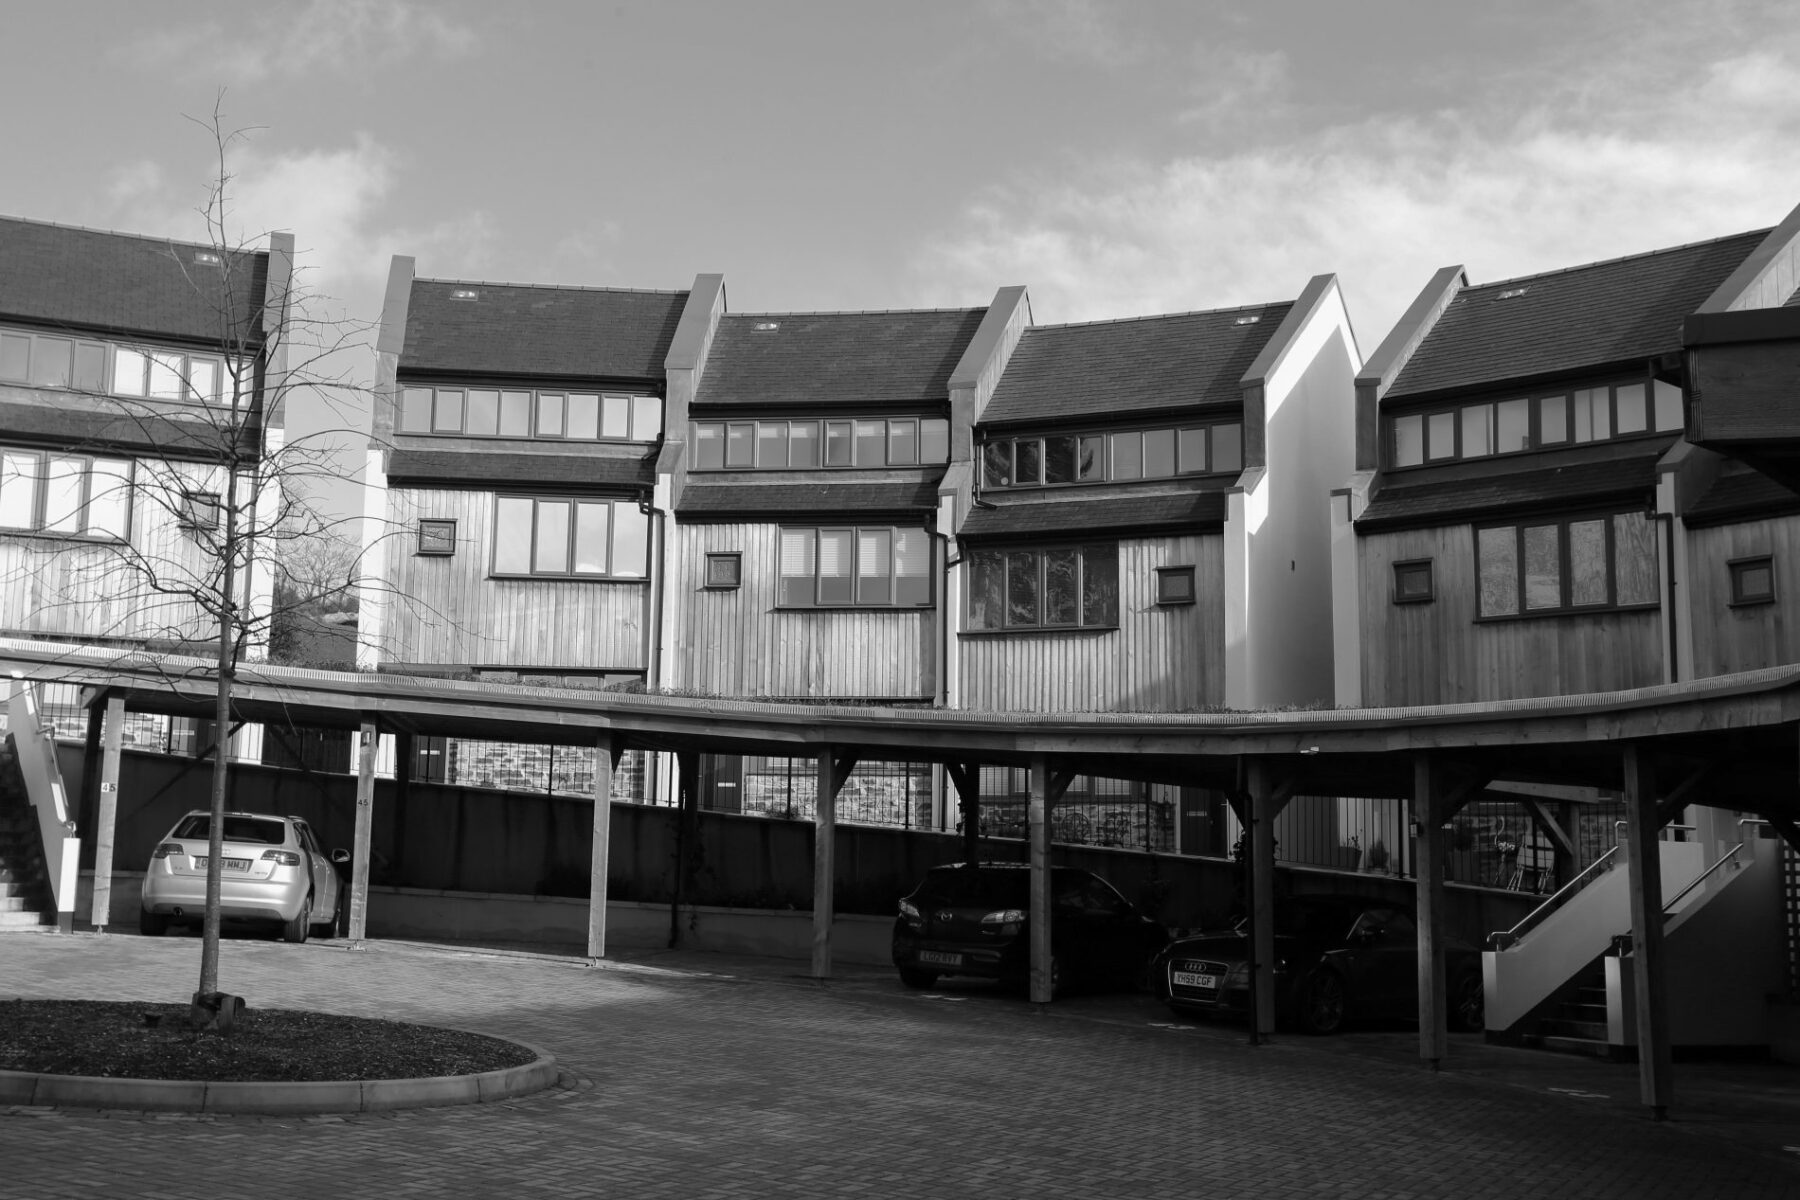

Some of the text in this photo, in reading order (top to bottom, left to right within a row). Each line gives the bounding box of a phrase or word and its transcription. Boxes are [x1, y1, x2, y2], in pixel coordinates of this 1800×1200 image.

[102, 783, 117, 792] 45
[1177, 973, 1213, 986] YH59 CGF
